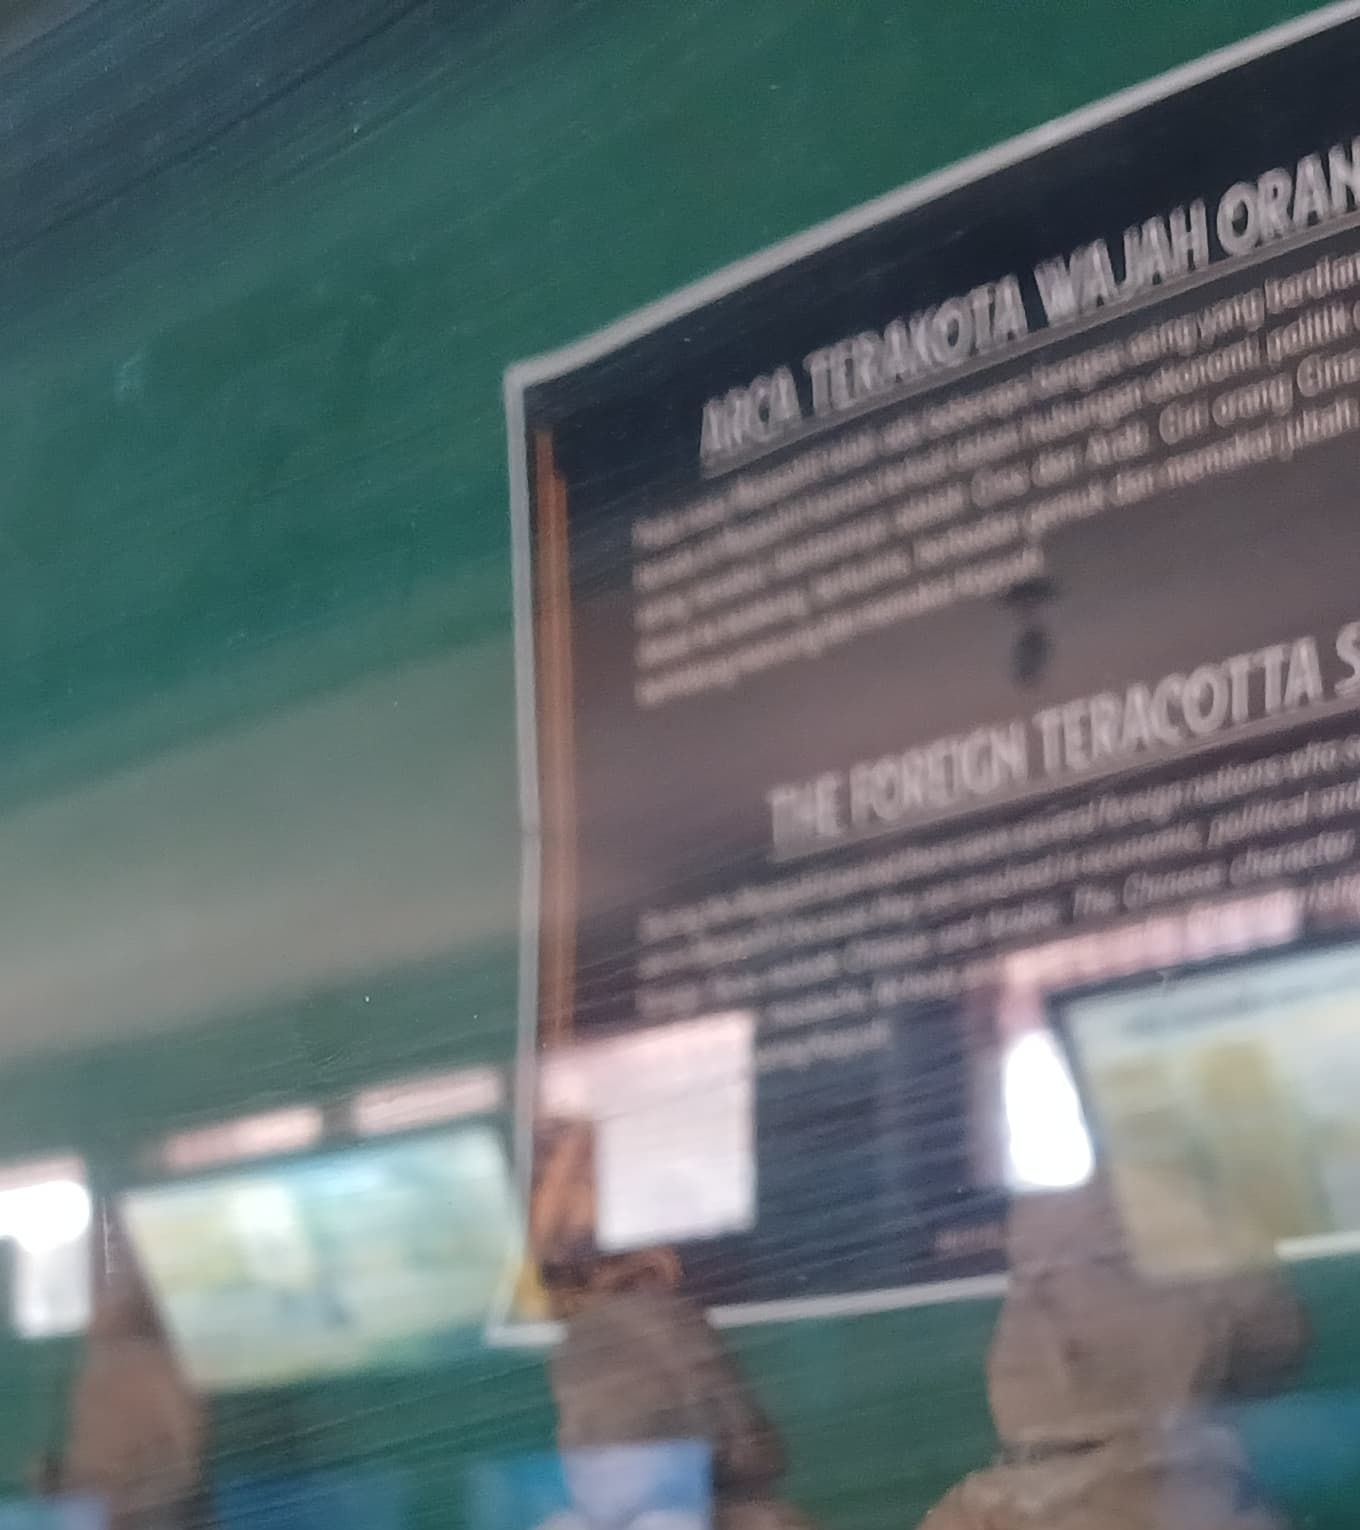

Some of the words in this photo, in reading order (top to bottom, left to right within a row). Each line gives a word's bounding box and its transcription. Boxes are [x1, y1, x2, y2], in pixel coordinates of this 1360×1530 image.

[700, 365, 804, 460] ARCA
[803, 272, 1029, 418] TERAKOTA
[1033, 198, 1210, 329] WAJAH
[1198, 287, 1266, 348] yang
[1212, 373, 1293, 428] orang
[847, 720, 1030, 827] FOREIGN
[1031, 636, 1324, 773] TERACOTTA
